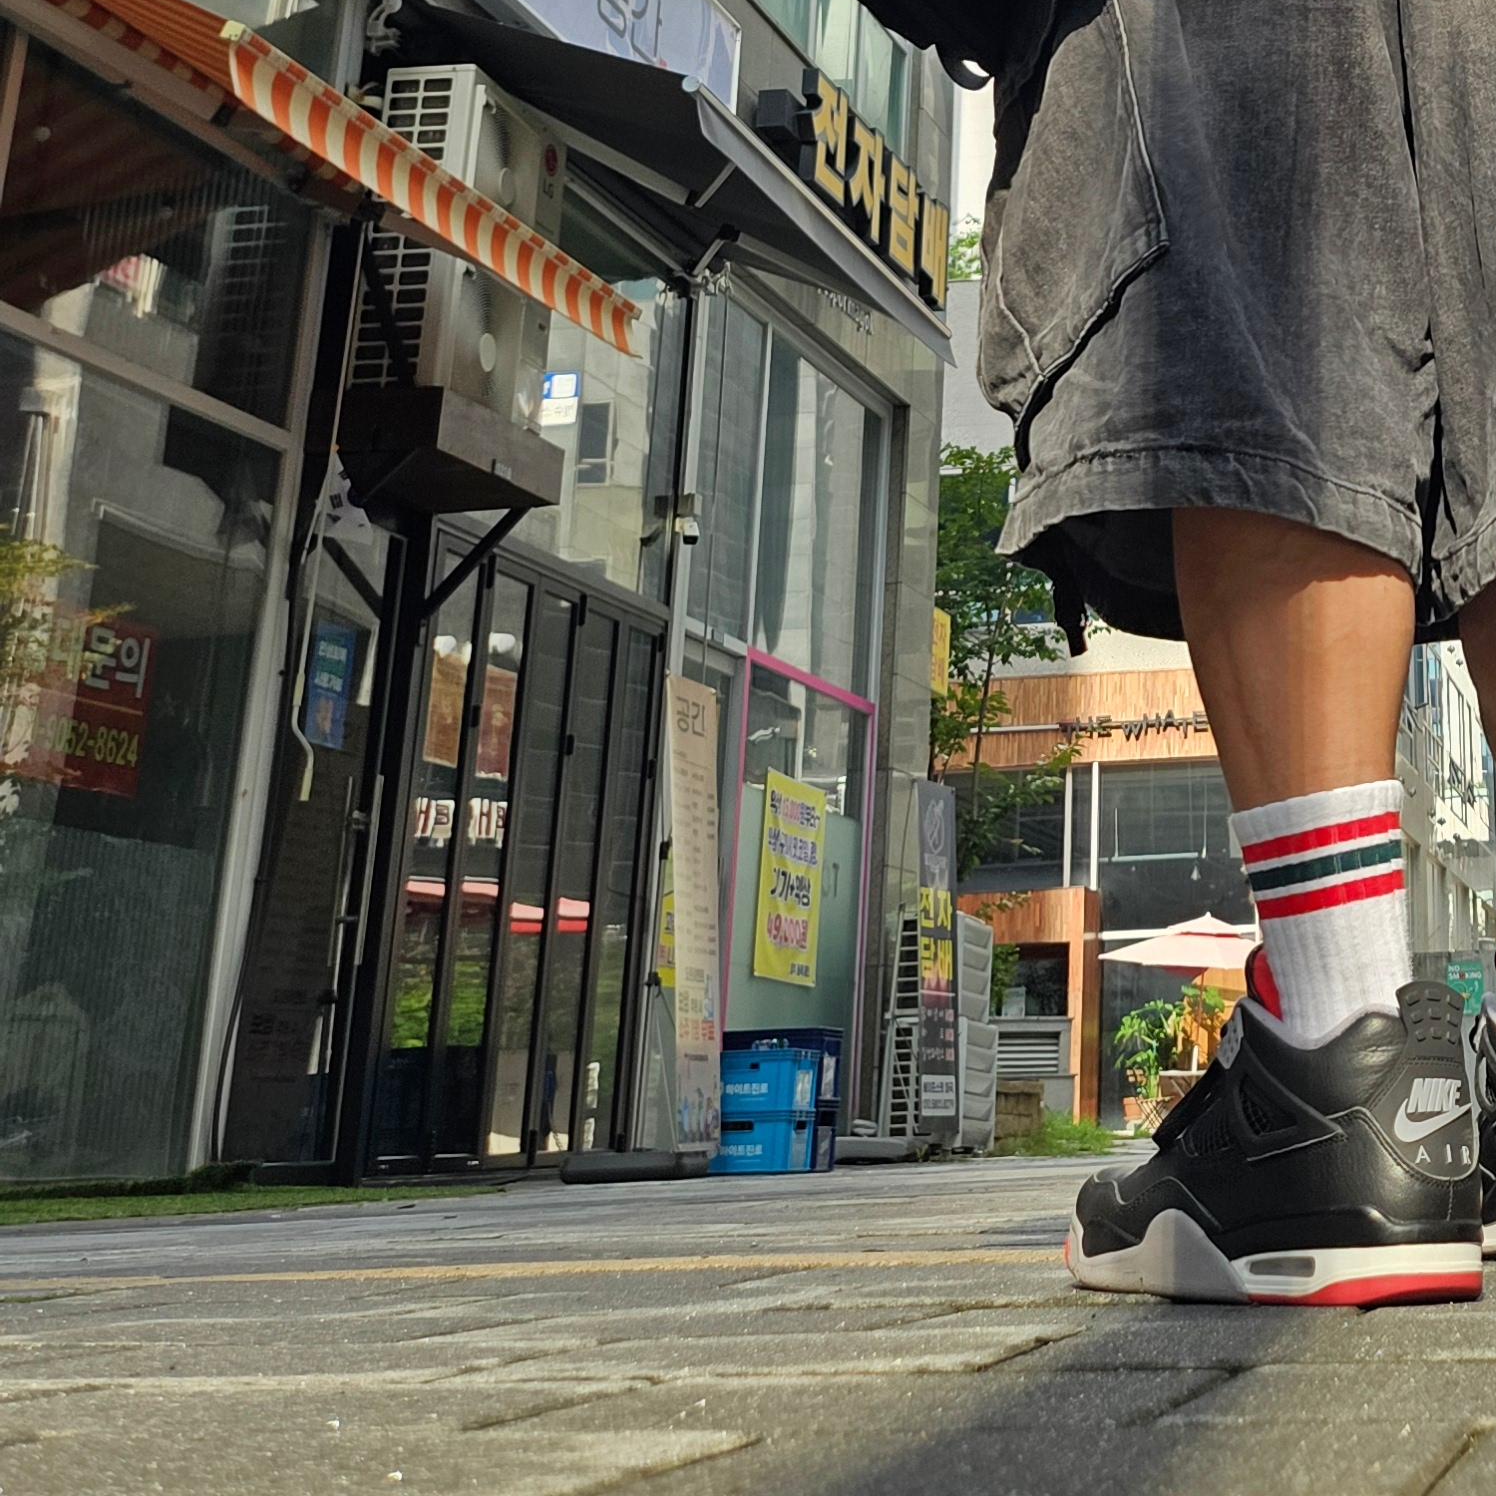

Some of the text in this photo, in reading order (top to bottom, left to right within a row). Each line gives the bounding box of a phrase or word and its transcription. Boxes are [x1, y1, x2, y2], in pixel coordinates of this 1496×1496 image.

[811, 68, 949, 311] 전자담배
[676, 696, 706, 738] 공간
[920, 886, 952, 931] 전자
[920, 936, 953, 981] 담배
[1448, 964, 1460, 973] NO
[725, 1082, 769, 1096] 하이트진로
[1407, 1077, 1462, 1113] NIKE
[1415, 1144, 1472, 1165] AIR
